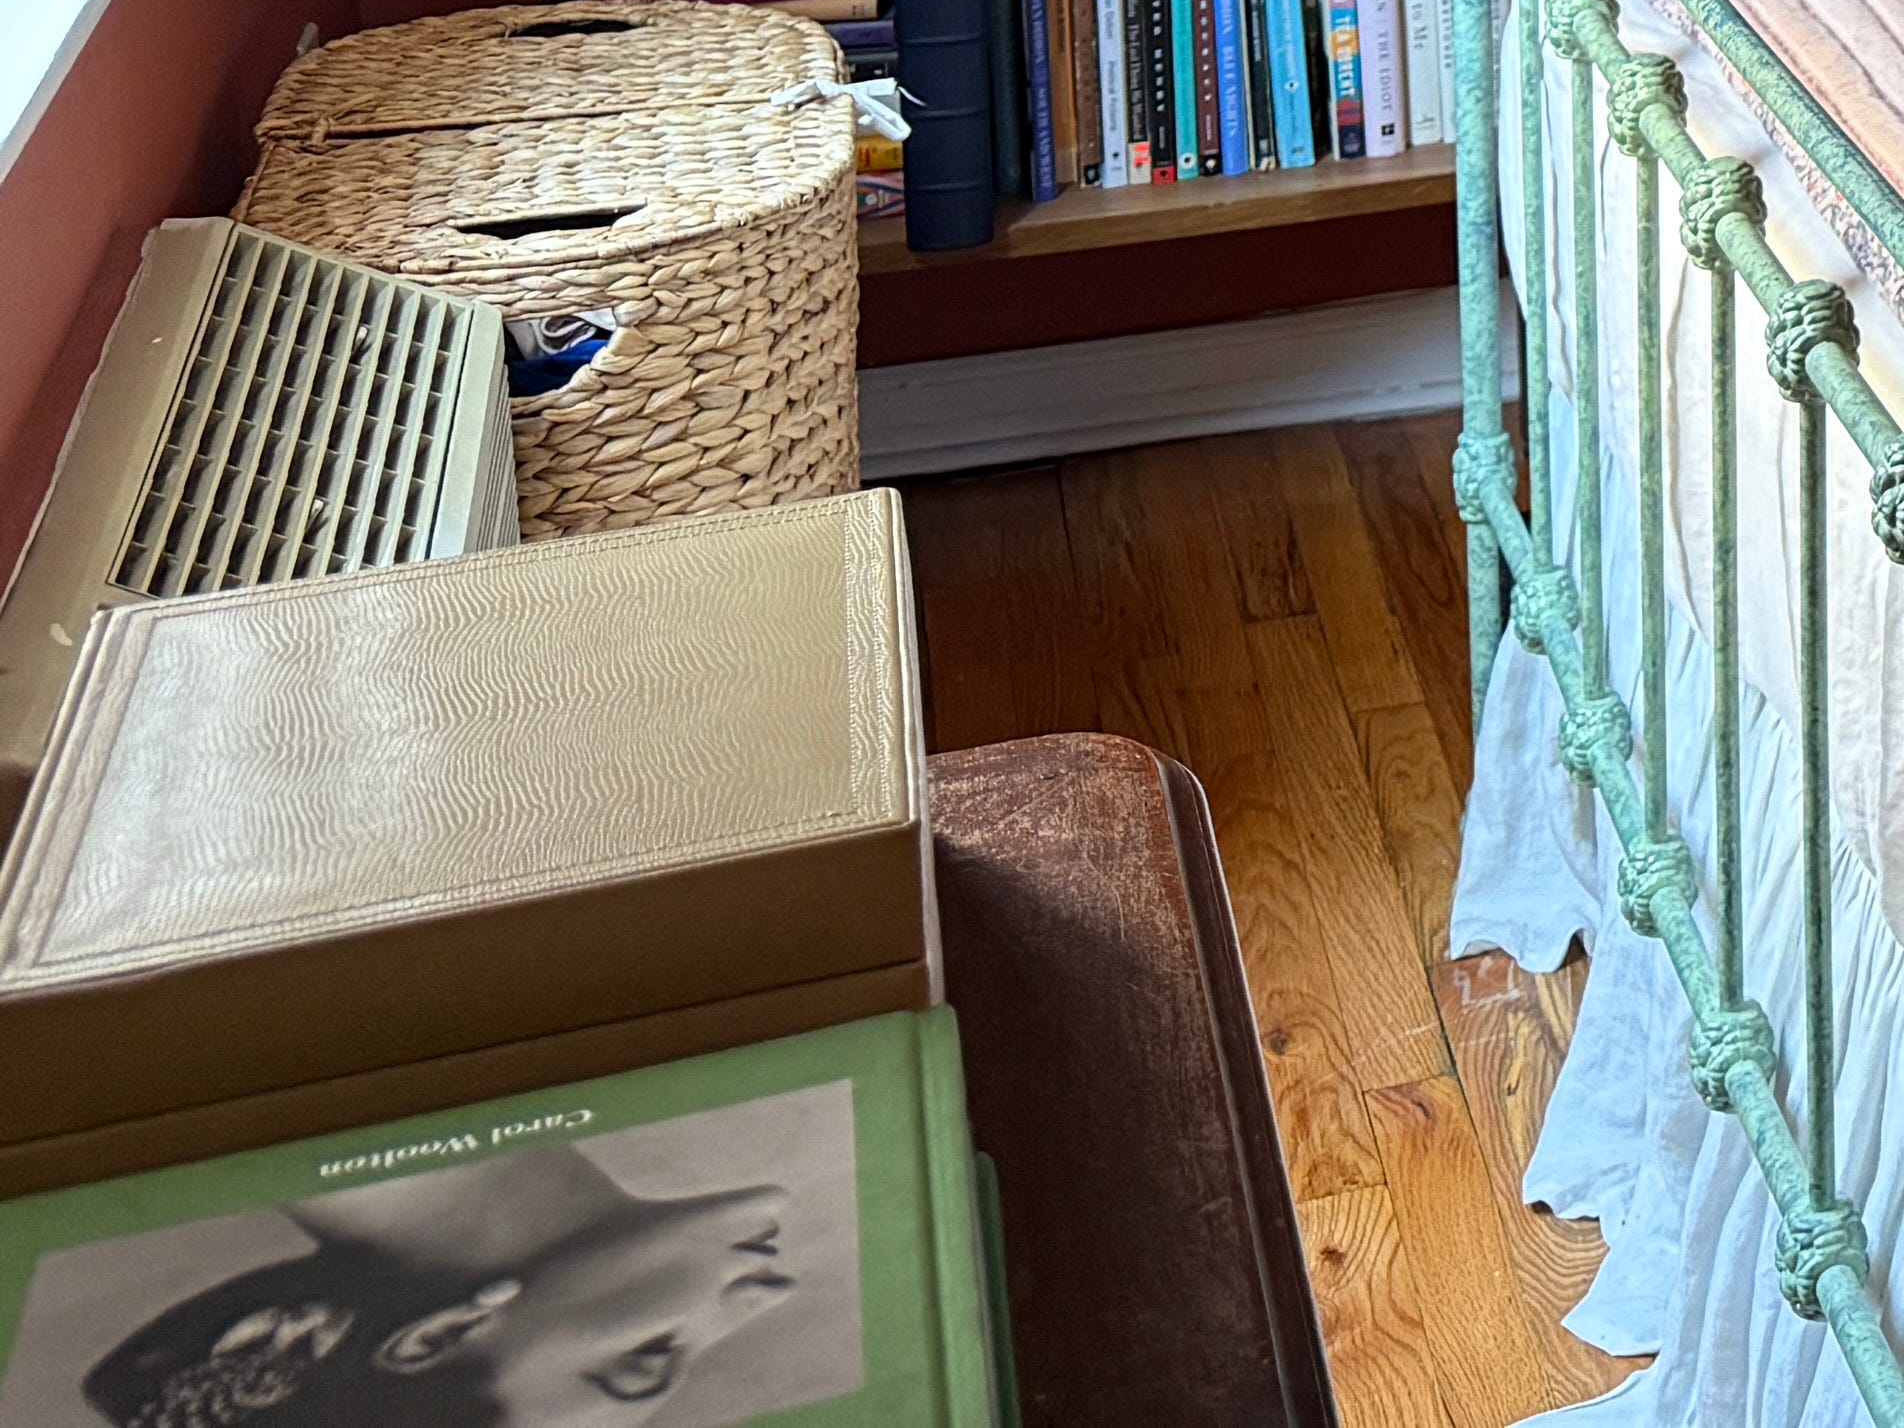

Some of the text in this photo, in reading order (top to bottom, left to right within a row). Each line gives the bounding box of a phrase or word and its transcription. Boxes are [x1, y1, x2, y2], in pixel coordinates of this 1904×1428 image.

[1412, 4, 1426, 21] to
[1378, 30, 1388, 61] THE
[1412, 26, 1427, 50] Me
[1154, 49, 1165, 113] HENRY
[1380, 68, 1392, 112] IDIOT
[319, 1108, 593, 1178] Carol Woolton
